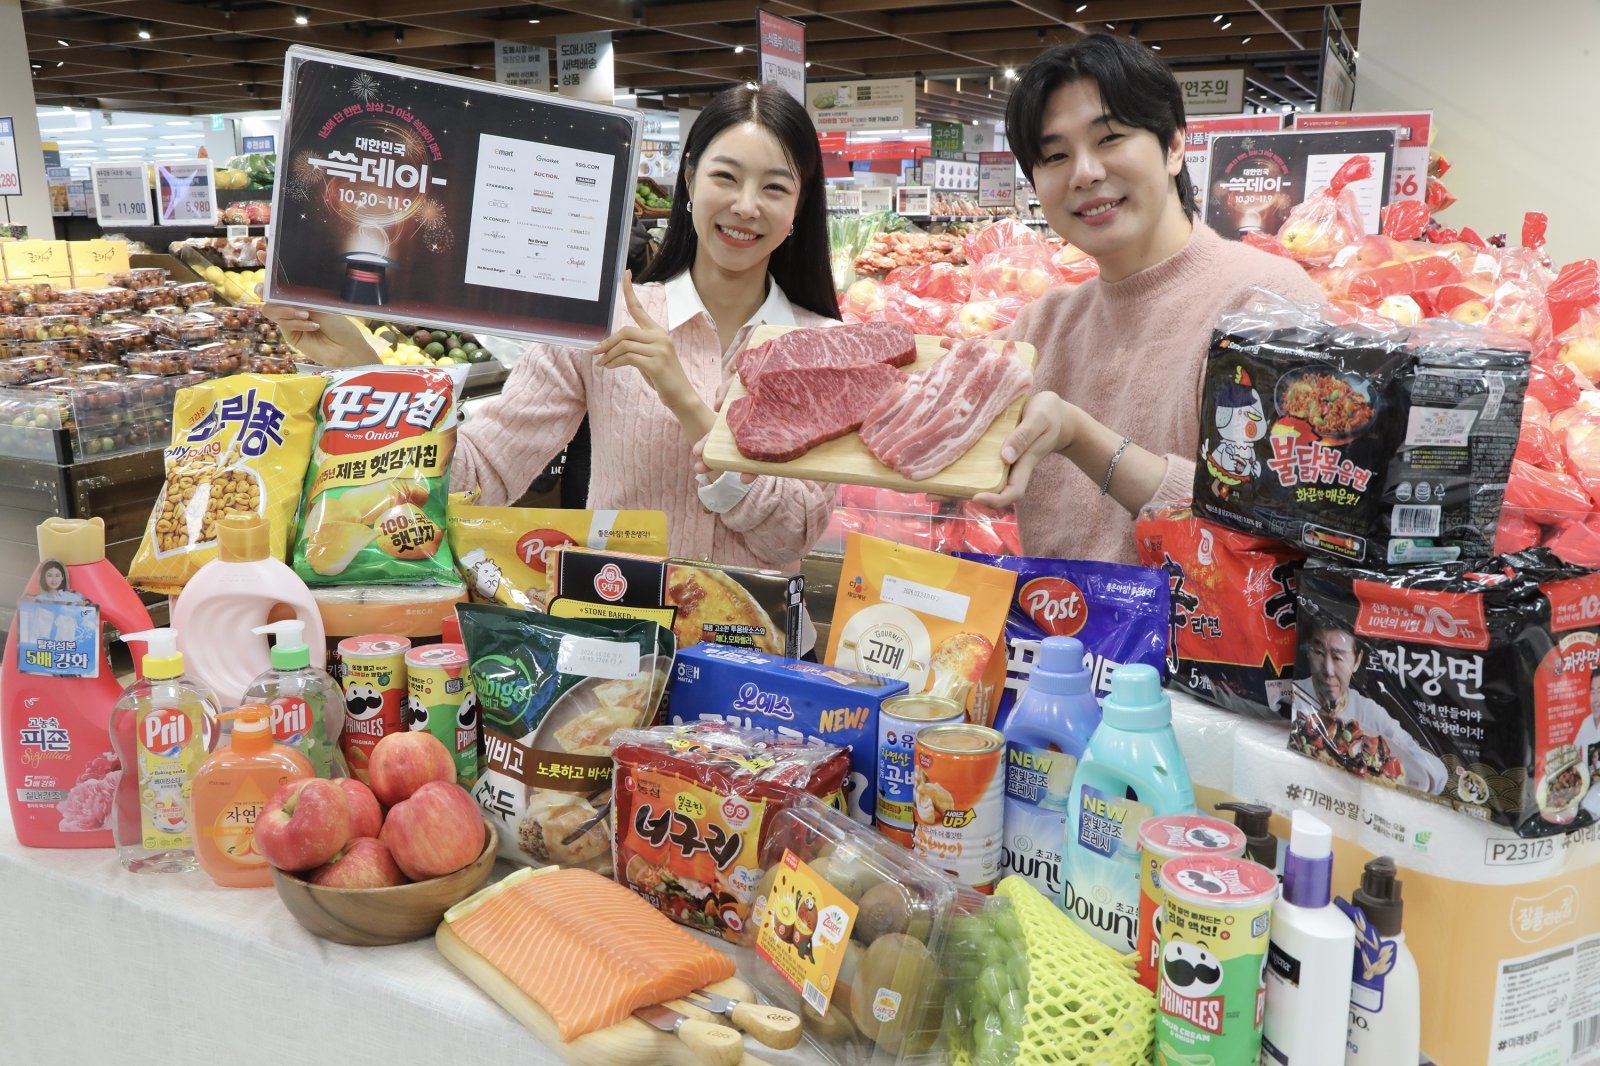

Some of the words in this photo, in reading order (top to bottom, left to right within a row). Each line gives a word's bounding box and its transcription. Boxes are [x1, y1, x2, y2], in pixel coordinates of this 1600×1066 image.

[561, 42, 597, 56] 도매시장
[562, 57, 597, 71] 새벽배송
[562, 73, 580, 86] 상품
[1180, 79, 1229, 98] 연주의
[365, 102, 385, 112] 상상
[386, 103, 395, 115] 그
[395, 109, 414, 122] 이상
[355, 136, 407, 157] 대한민국
[575, 161, 600, 171] SSG.COM
[1243, 168, 1270, 176] 대한민국
[118, 202, 146, 215] 11,900
[185, 200, 210, 214] 5,980
[327, 385, 446, 431] 포카칩
[365, 430, 400, 441] Onion
[336, 460, 367, 479] 제철
[371, 445, 438, 478] 햇감자칩
[1267, 433, 1371, 492] 불닭볶음면
[1296, 487, 1324, 503] 화끈한
[1325, 488, 1360, 506] 매운맛!
[391, 526, 435, 553] 햇감자
[601, 583, 621, 595] 오뚜기
[584, 606, 607, 618] STONE
[608, 610, 632, 620] BAKED
[1026, 588, 1081, 622] Post
[1368, 616, 1399, 630] 10년의
[37, 639, 76, 652] 탈취성분
[874, 630, 903, 643] GOURMET
[26, 649, 52, 668] 5배
[55, 652, 88, 670] 강화
[863, 639, 904, 670] 고메
[1563, 648, 1600, 674] 짜장면
[677, 676, 693, 684] HAITAI
[1377, 645, 1486, 700] 짜장면
[474, 672, 528, 708] bibigo
[733, 682, 795, 720] 오예스
[28, 716, 59, 729] 고농축
[271, 702, 306, 736] Pril
[819, 706, 869, 734] NEW!
[1437, 705, 1482, 723] 만들어야
[145, 714, 185, 748] Pril
[346, 715, 384, 737] PRINGLES
[20, 728, 70, 752] 피죤
[351, 738, 375, 746] ORIGINAL
[900, 734, 914, 749] 유
[21, 748, 72, 768] Signature
[880, 747, 911, 767] 자연산
[1009, 748, 1052, 774] NEW
[536, 762, 585, 780] 노릇하고
[1008, 766, 1049, 789] 햇빛건조
[25, 790, 61, 801] 실내건조
[1008, 782, 1037, 800] 프레시
[677, 794, 704, 815] 얼큰한
[1083, 793, 1128, 824] NEW
[1286, 783, 1360, 821] #미래생활
[943, 817, 963, 828] UP
[1082, 813, 1123, 840] 햇빛건조
[634, 803, 743, 871] 너구리
[1081, 828, 1111, 851] 프레시
[1035, 849, 1063, 862] 초고농
[1493, 838, 1553, 861] P23173
[1001, 846, 1062, 894] owny
[1115, 902, 1140, 916] 초고
[822, 913, 842, 935] Zespri
[1187, 921, 1218, 937] 액션!
[1160, 978, 1220, 1031] PRINGLES
[1162, 1016, 1179, 1033] SOUR
[1180, 1026, 1211, 1042] CREAM
[1175, 1034, 1196, 1045] ONION
